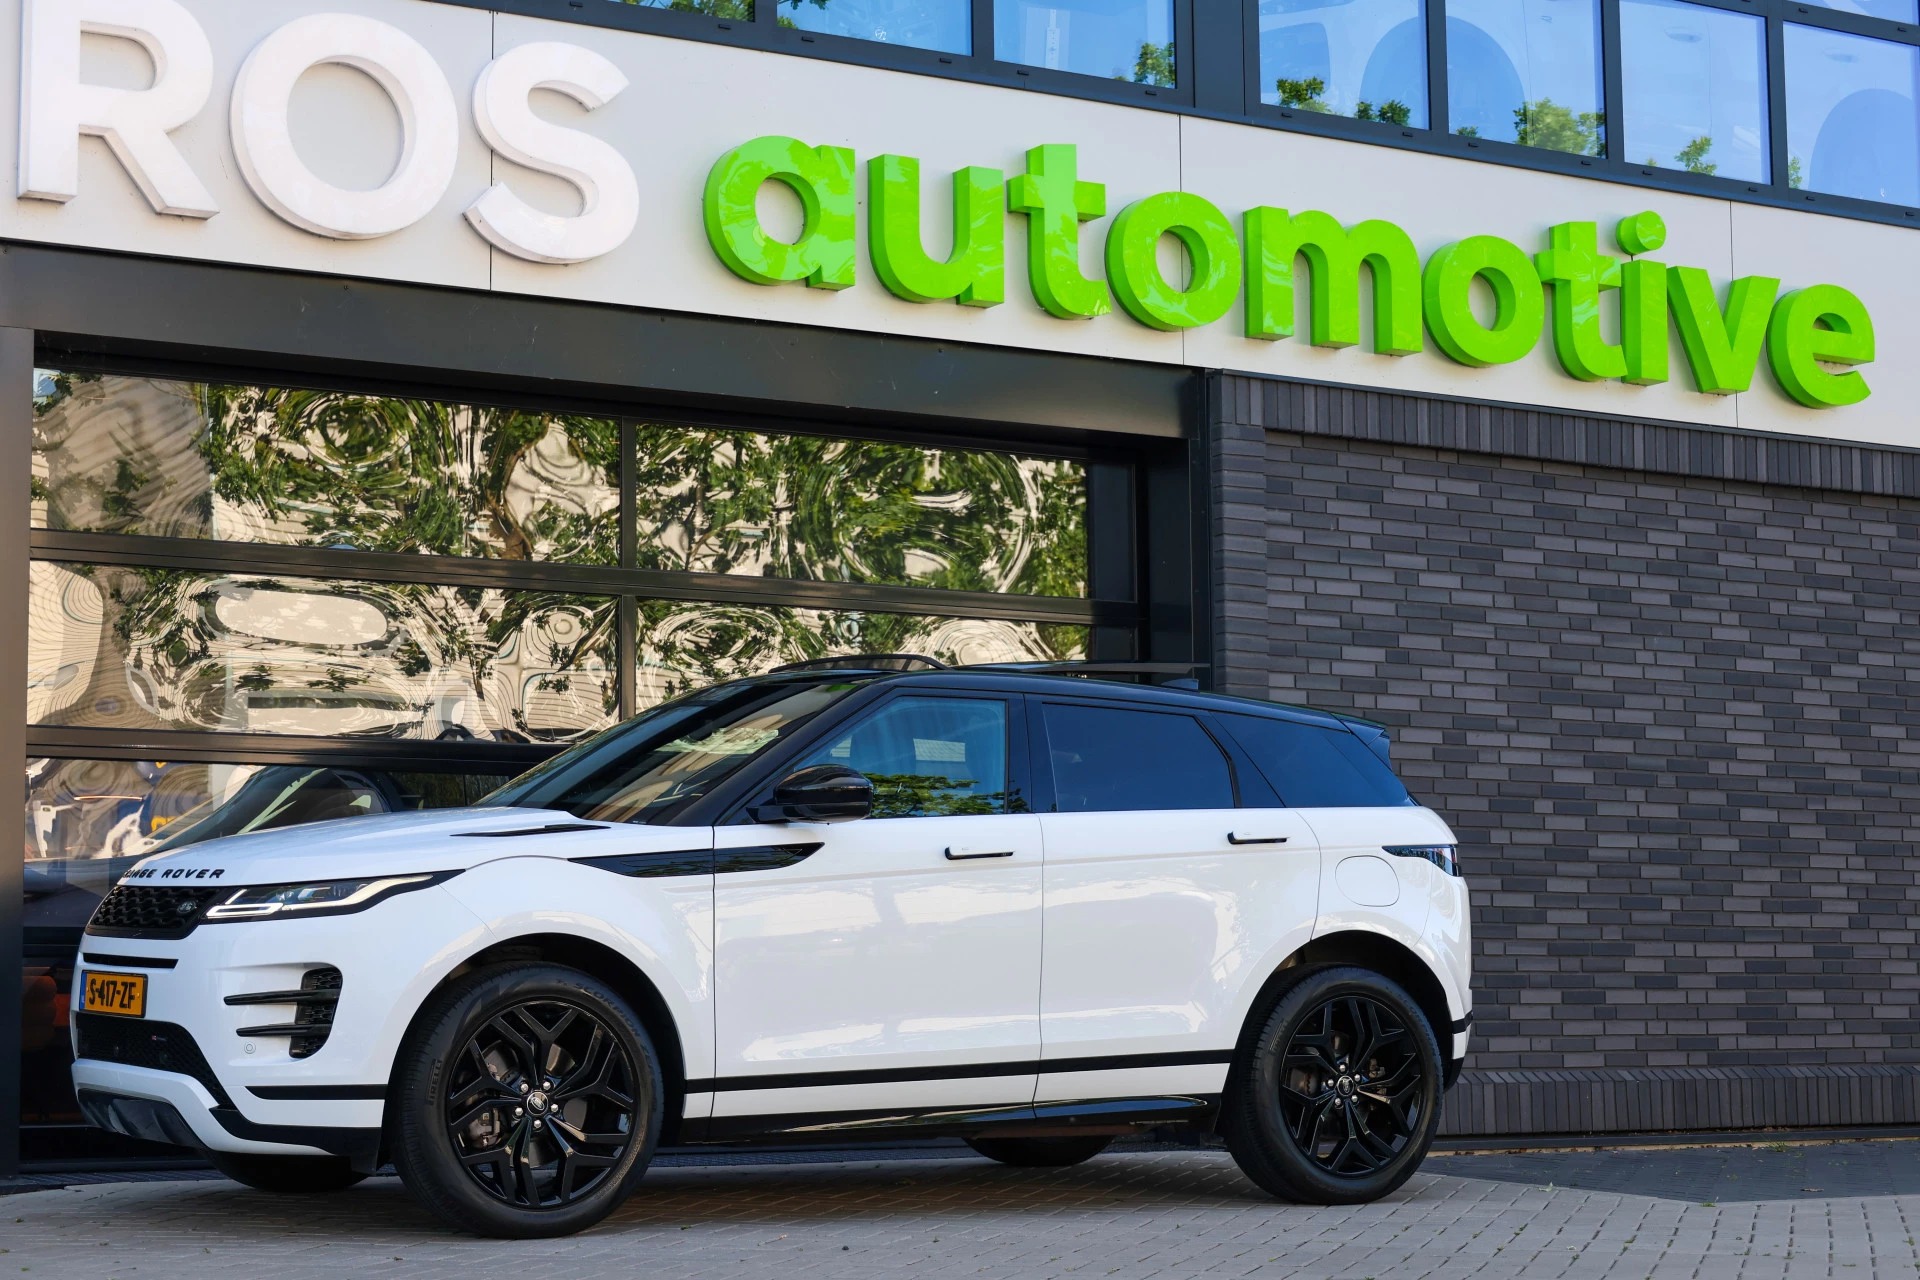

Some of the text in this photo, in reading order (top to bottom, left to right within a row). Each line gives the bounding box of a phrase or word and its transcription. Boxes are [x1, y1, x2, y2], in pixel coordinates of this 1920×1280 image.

[17, 0, 1874, 408] ROS automotive
[161, 869, 225, 879] ROVER
[89, 978, 136, 1009] S-417-ZF
[424, 1058, 443, 1106] PIRELLI
